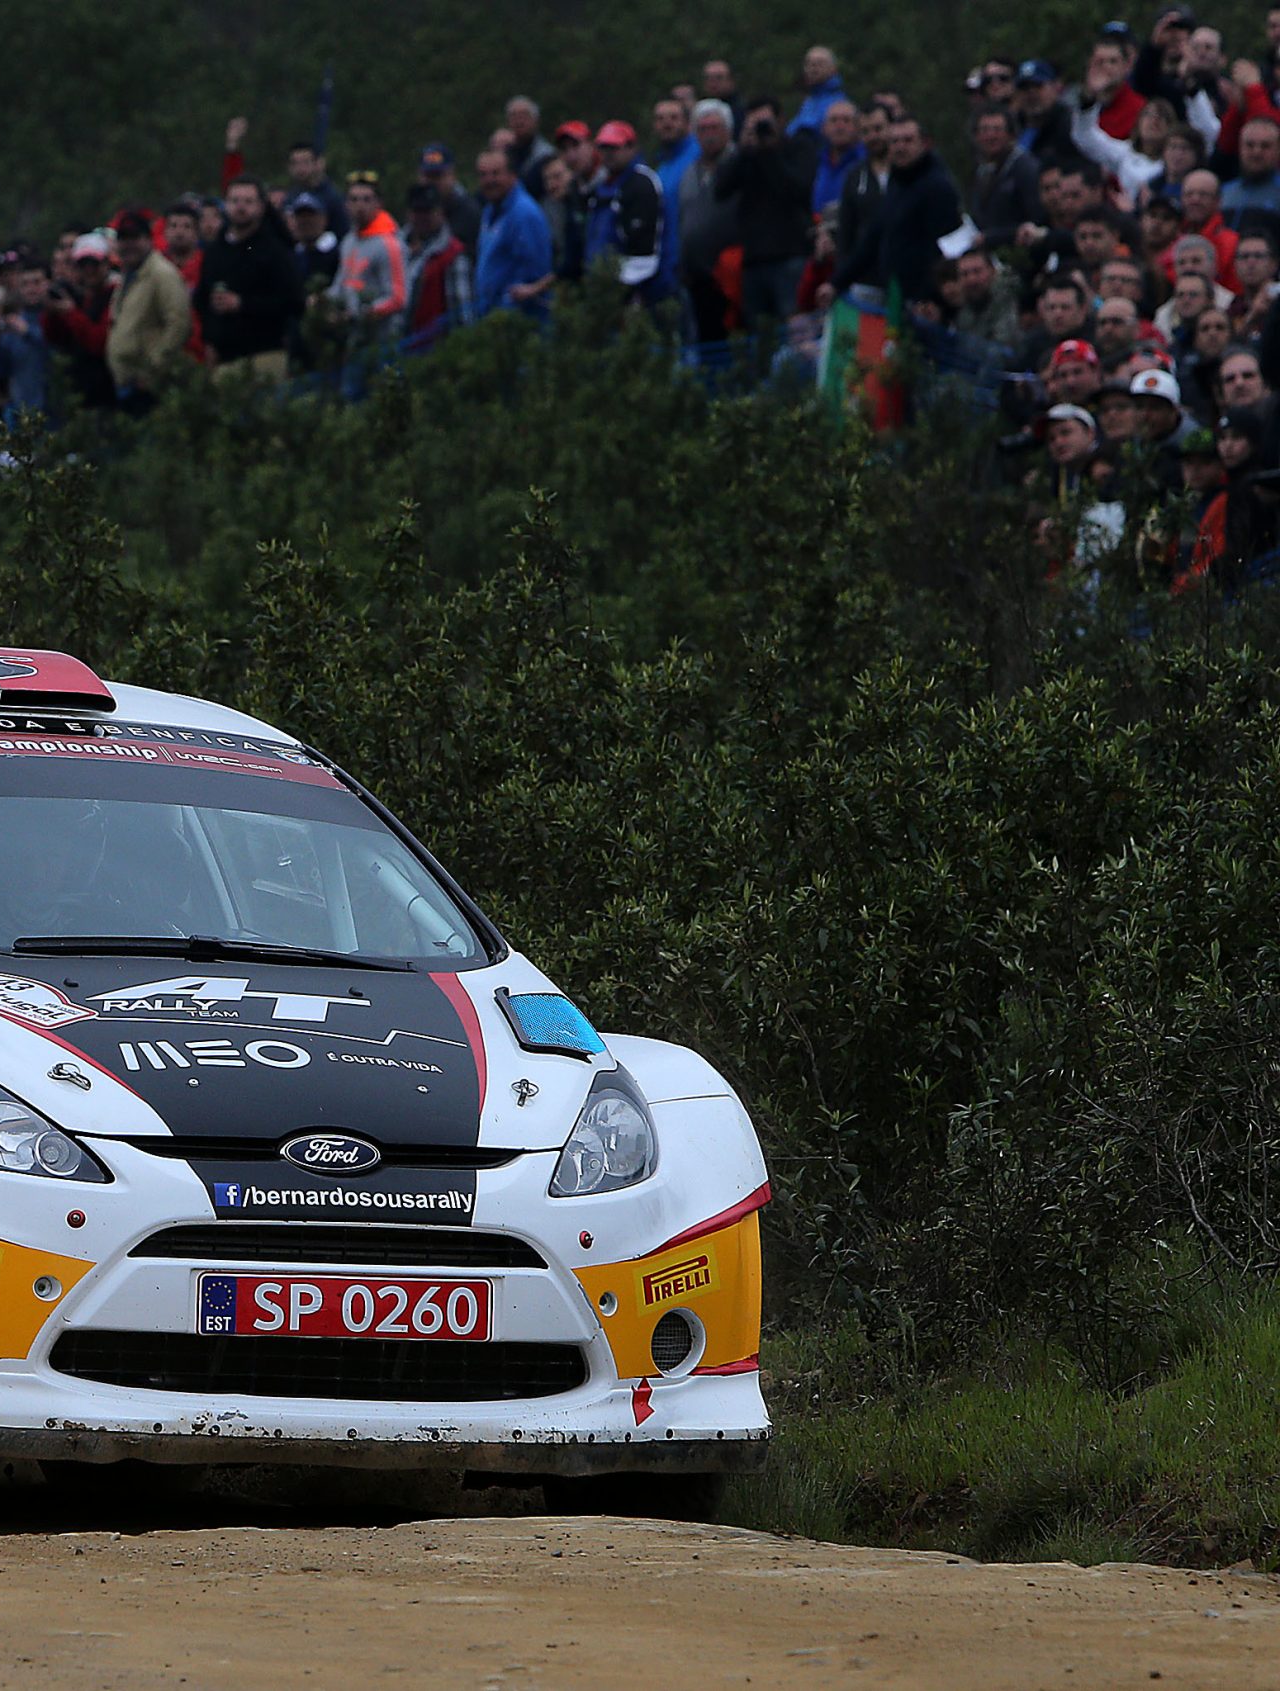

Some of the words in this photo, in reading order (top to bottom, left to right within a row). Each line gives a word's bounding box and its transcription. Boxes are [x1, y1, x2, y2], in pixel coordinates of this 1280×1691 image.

[65, 722, 86, 733] E
[102, 725, 263, 753] BENFICA
[103, 1000, 219, 1012] RALLY
[186, 1010, 240, 1019] TEAM
[119, 1039, 312, 1070] MEO
[341, 1054, 400, 1068] OUTRA
[400, 1060, 443, 1074] VIDA
[304, 1138, 359, 1165] Ford
[642, 1254, 709, 1306] PIRELLI
[253, 1282, 323, 1332] SP
[341, 1284, 478, 1335] 0260
[205, 1315, 231, 1332] EST
